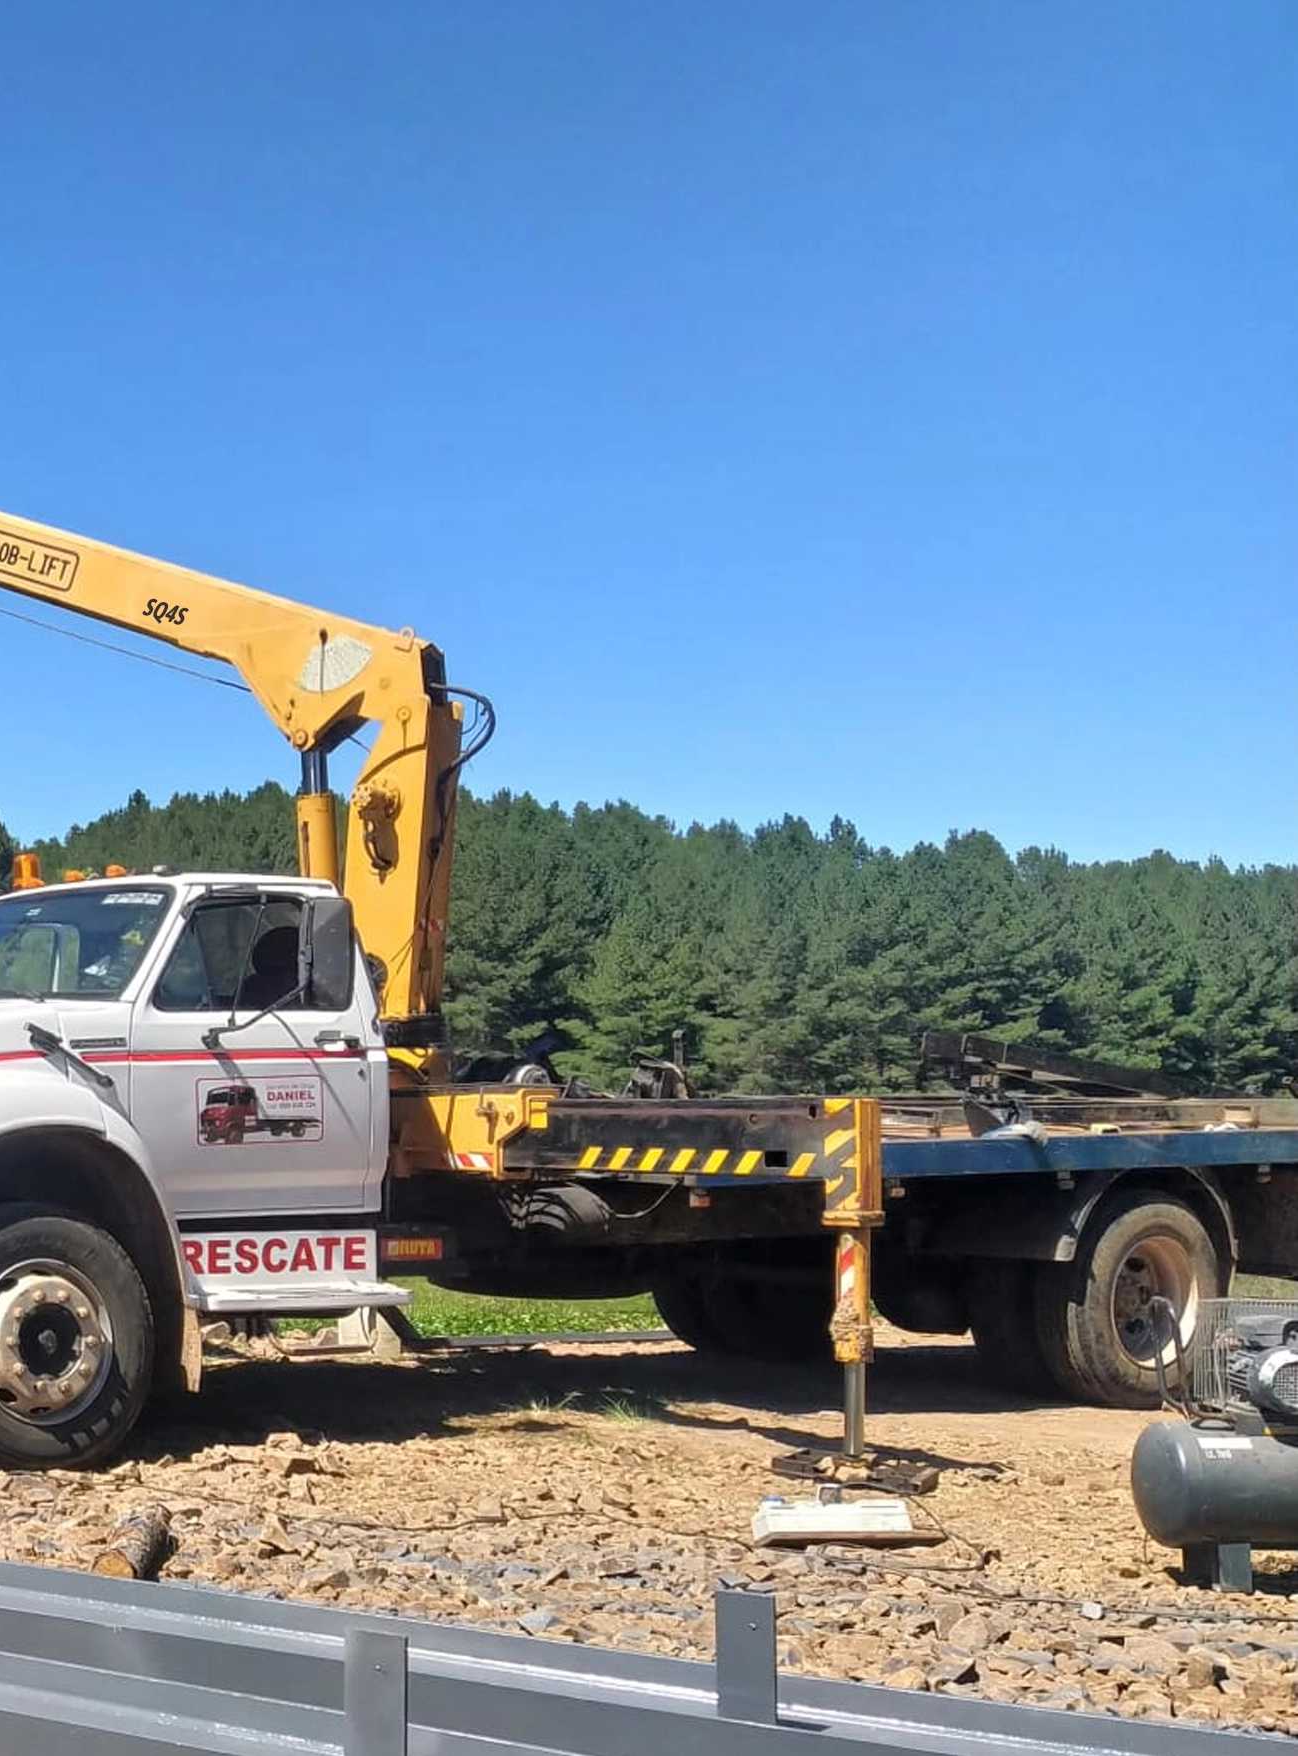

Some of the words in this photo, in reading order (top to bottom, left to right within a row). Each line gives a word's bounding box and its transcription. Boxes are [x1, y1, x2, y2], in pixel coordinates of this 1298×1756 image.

[142, 597, 189, 625] SQ4S
[266, 1090, 315, 1101] DANIEL
[180, 1236, 367, 1275] RESCATE
